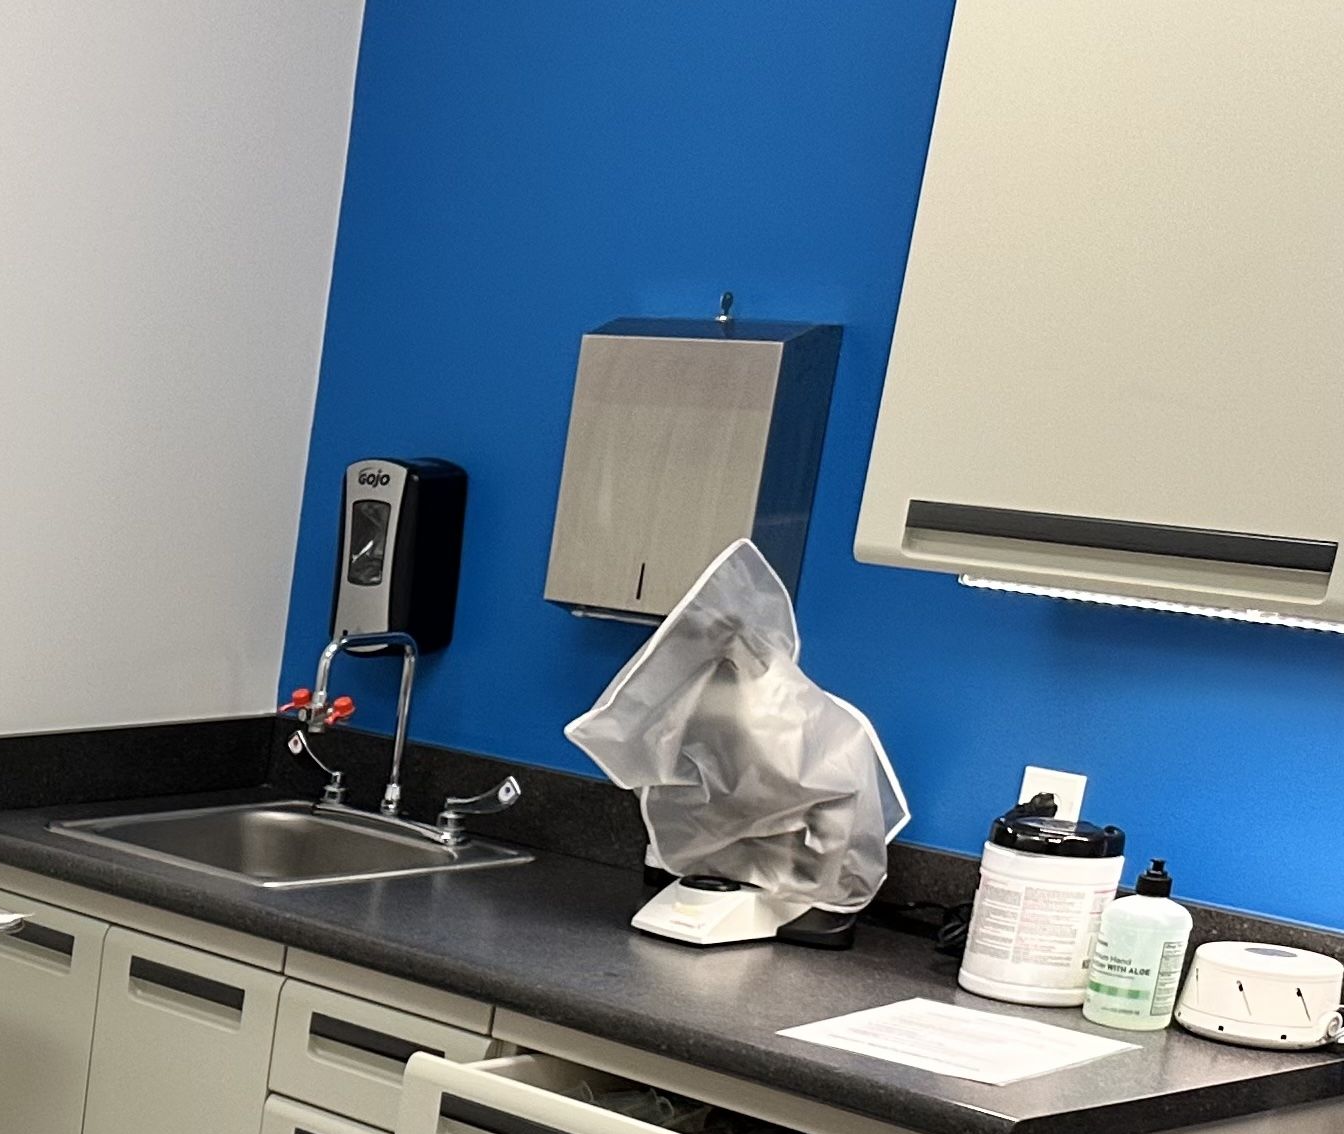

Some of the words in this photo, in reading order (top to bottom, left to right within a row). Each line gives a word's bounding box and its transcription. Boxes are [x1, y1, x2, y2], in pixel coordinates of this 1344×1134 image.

[1110, 956, 1132, 966] Hand
[1107, 963, 1127, 973] WITH
[1128, 968, 1151, 977] ALOE
